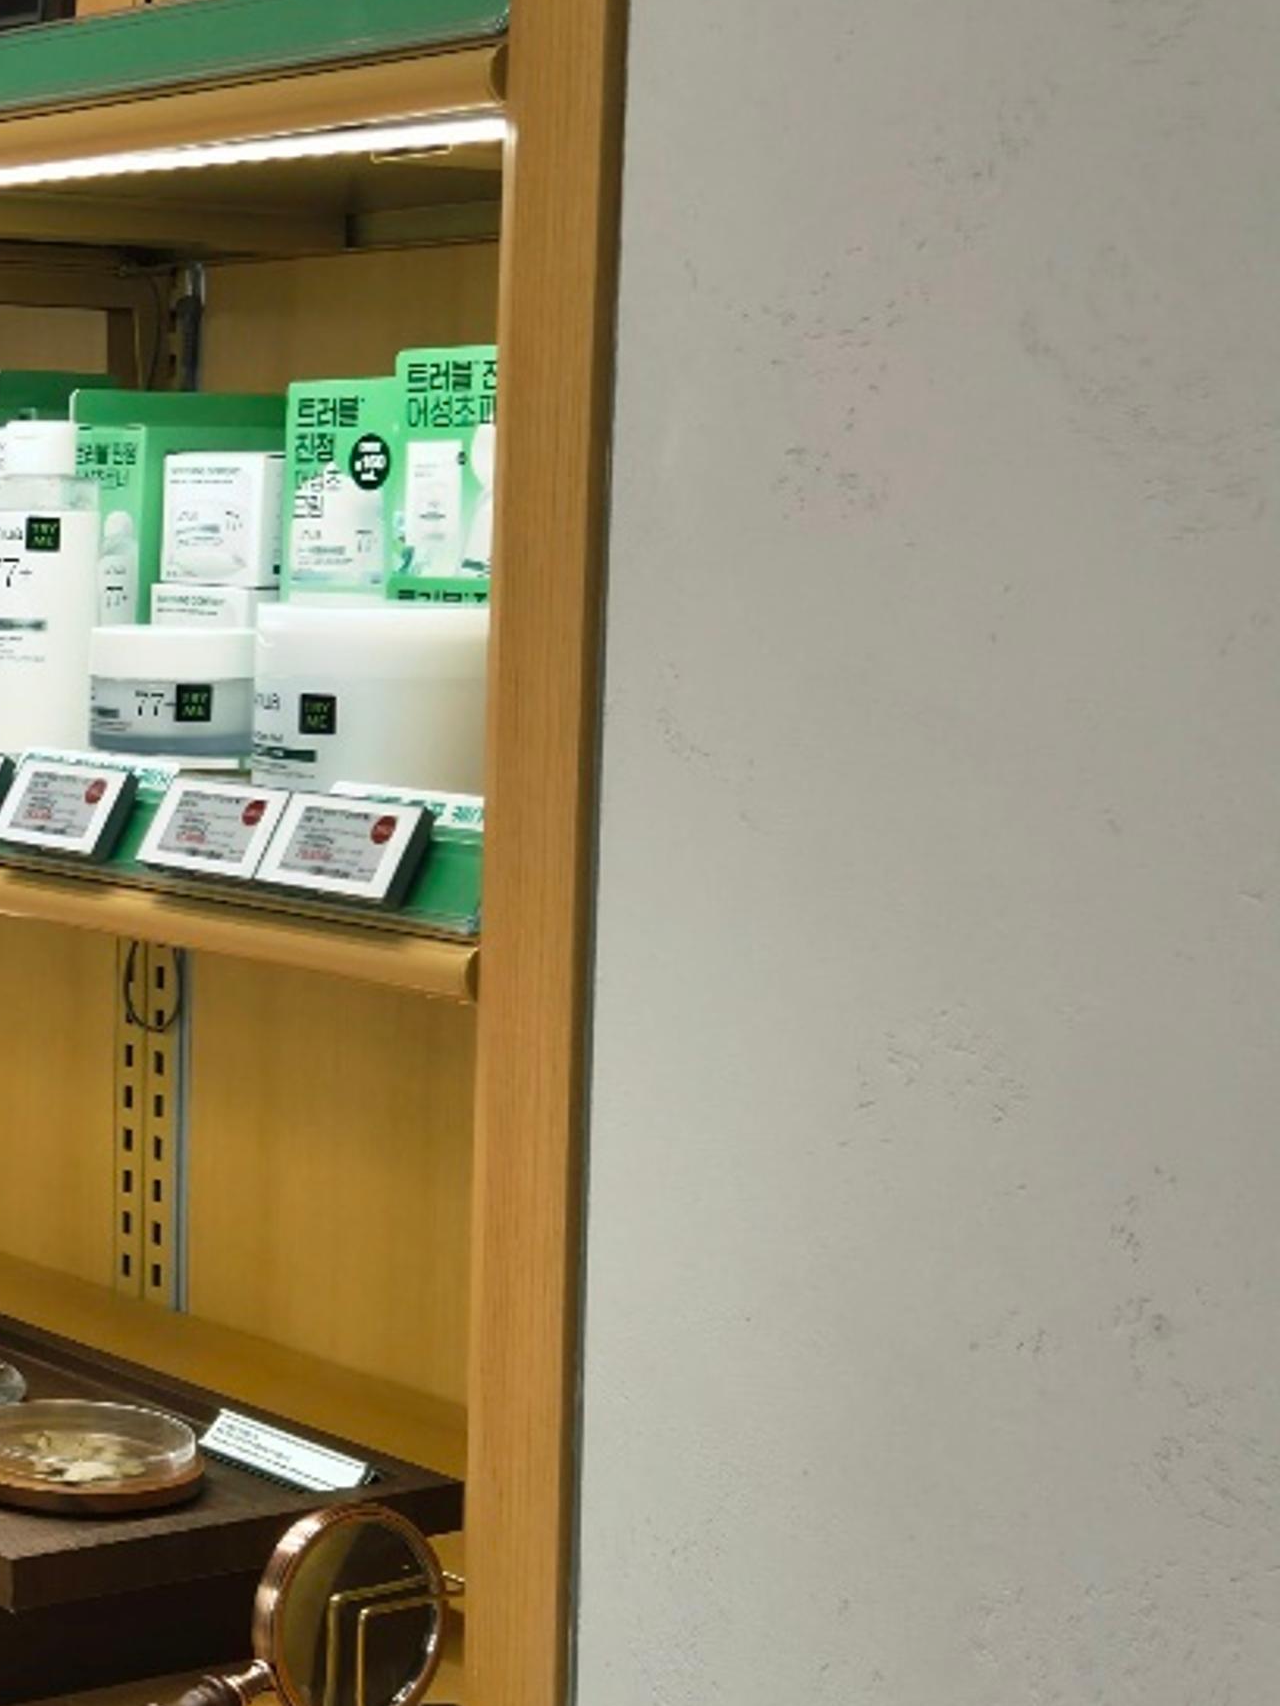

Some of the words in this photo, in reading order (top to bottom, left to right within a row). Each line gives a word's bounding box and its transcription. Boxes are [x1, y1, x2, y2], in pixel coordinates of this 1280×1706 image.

[407, 359, 473, 394] 트러블
[296, 395, 360, 428] 트러블
[295, 430, 336, 464] 진정
